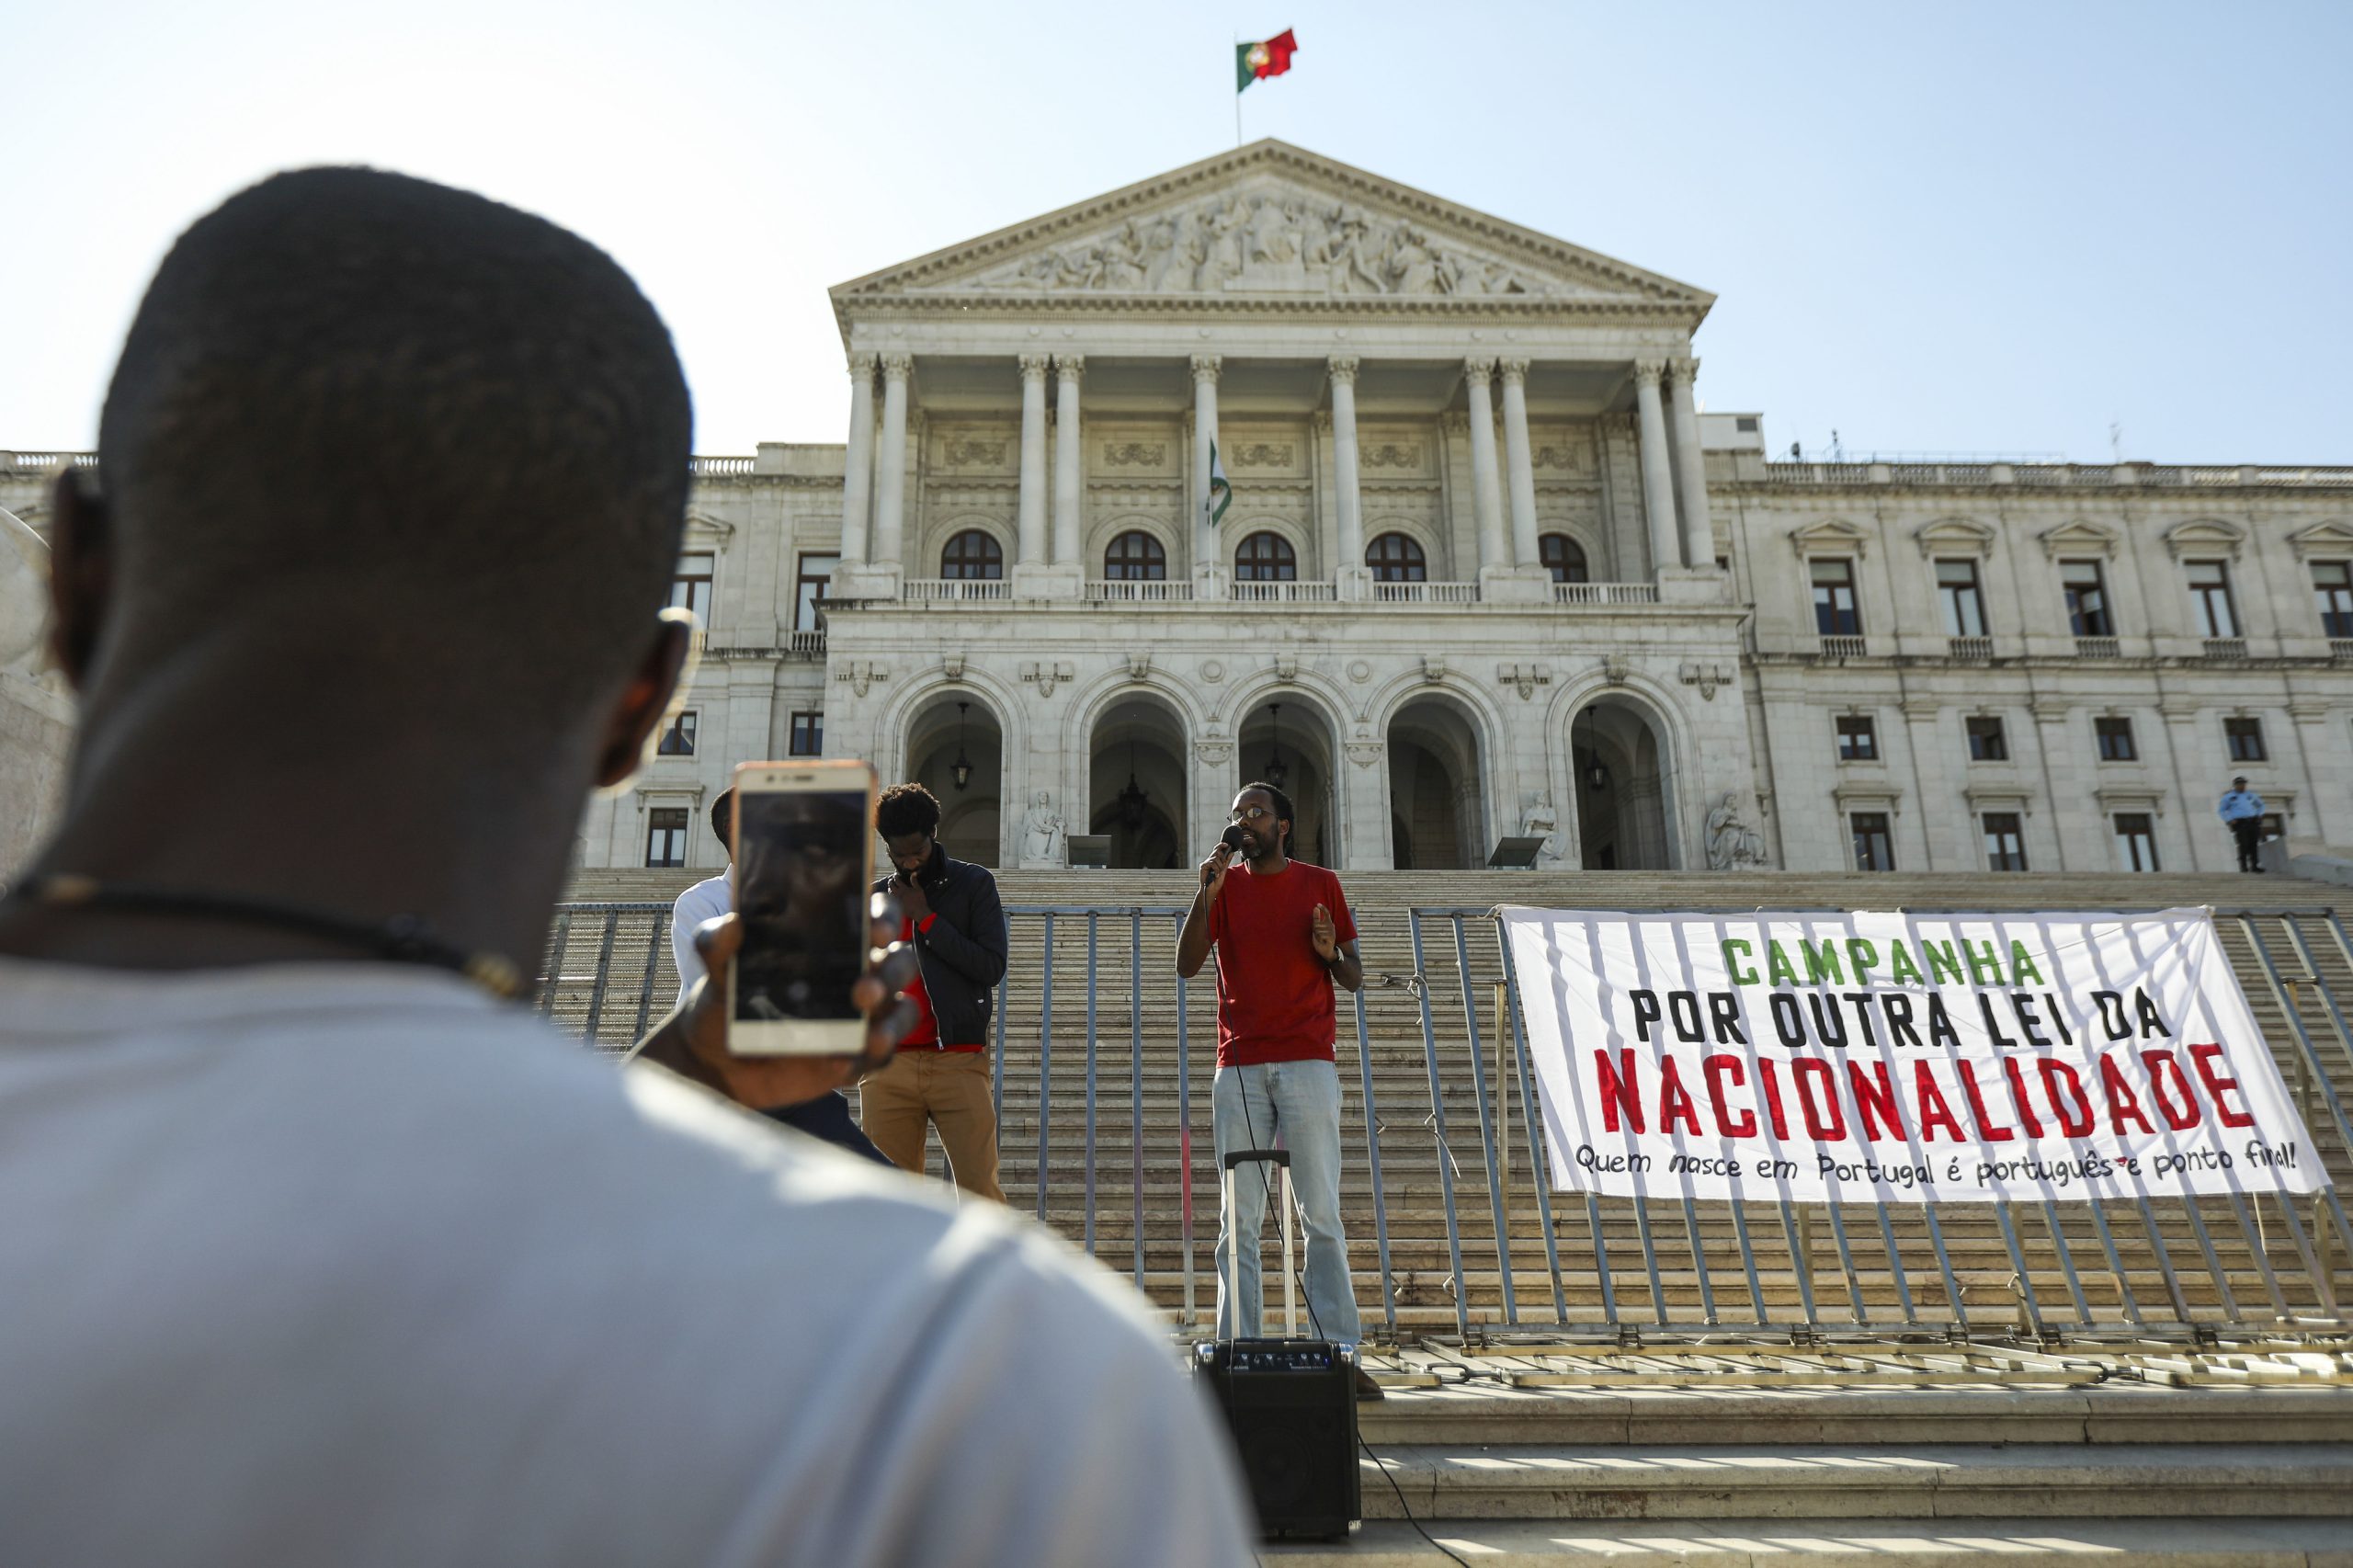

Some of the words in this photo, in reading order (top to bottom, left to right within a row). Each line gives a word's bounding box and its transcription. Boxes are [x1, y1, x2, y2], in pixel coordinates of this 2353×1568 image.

[1722, 938, 2045, 986] CAMPANHA
[1630, 989, 1748, 1044] POR
[1768, 991, 1961, 1048] OUTRA
[1979, 993, 2073, 1046] LEI
[2091, 986, 2171, 1040] DA
[1594, 1043, 2256, 1143] NACIONALIDADE
[1575, 1143, 1652, 1175] Quem
[1668, 1153, 1743, 1177] nasce
[1756, 1158, 1798, 1179] em
[1816, 1152, 1934, 1189] Portugal
[1947, 1156, 1962, 1181] é
[2153, 1145, 2234, 1180] ponto
[2244, 1140, 2297, 1169] final!
